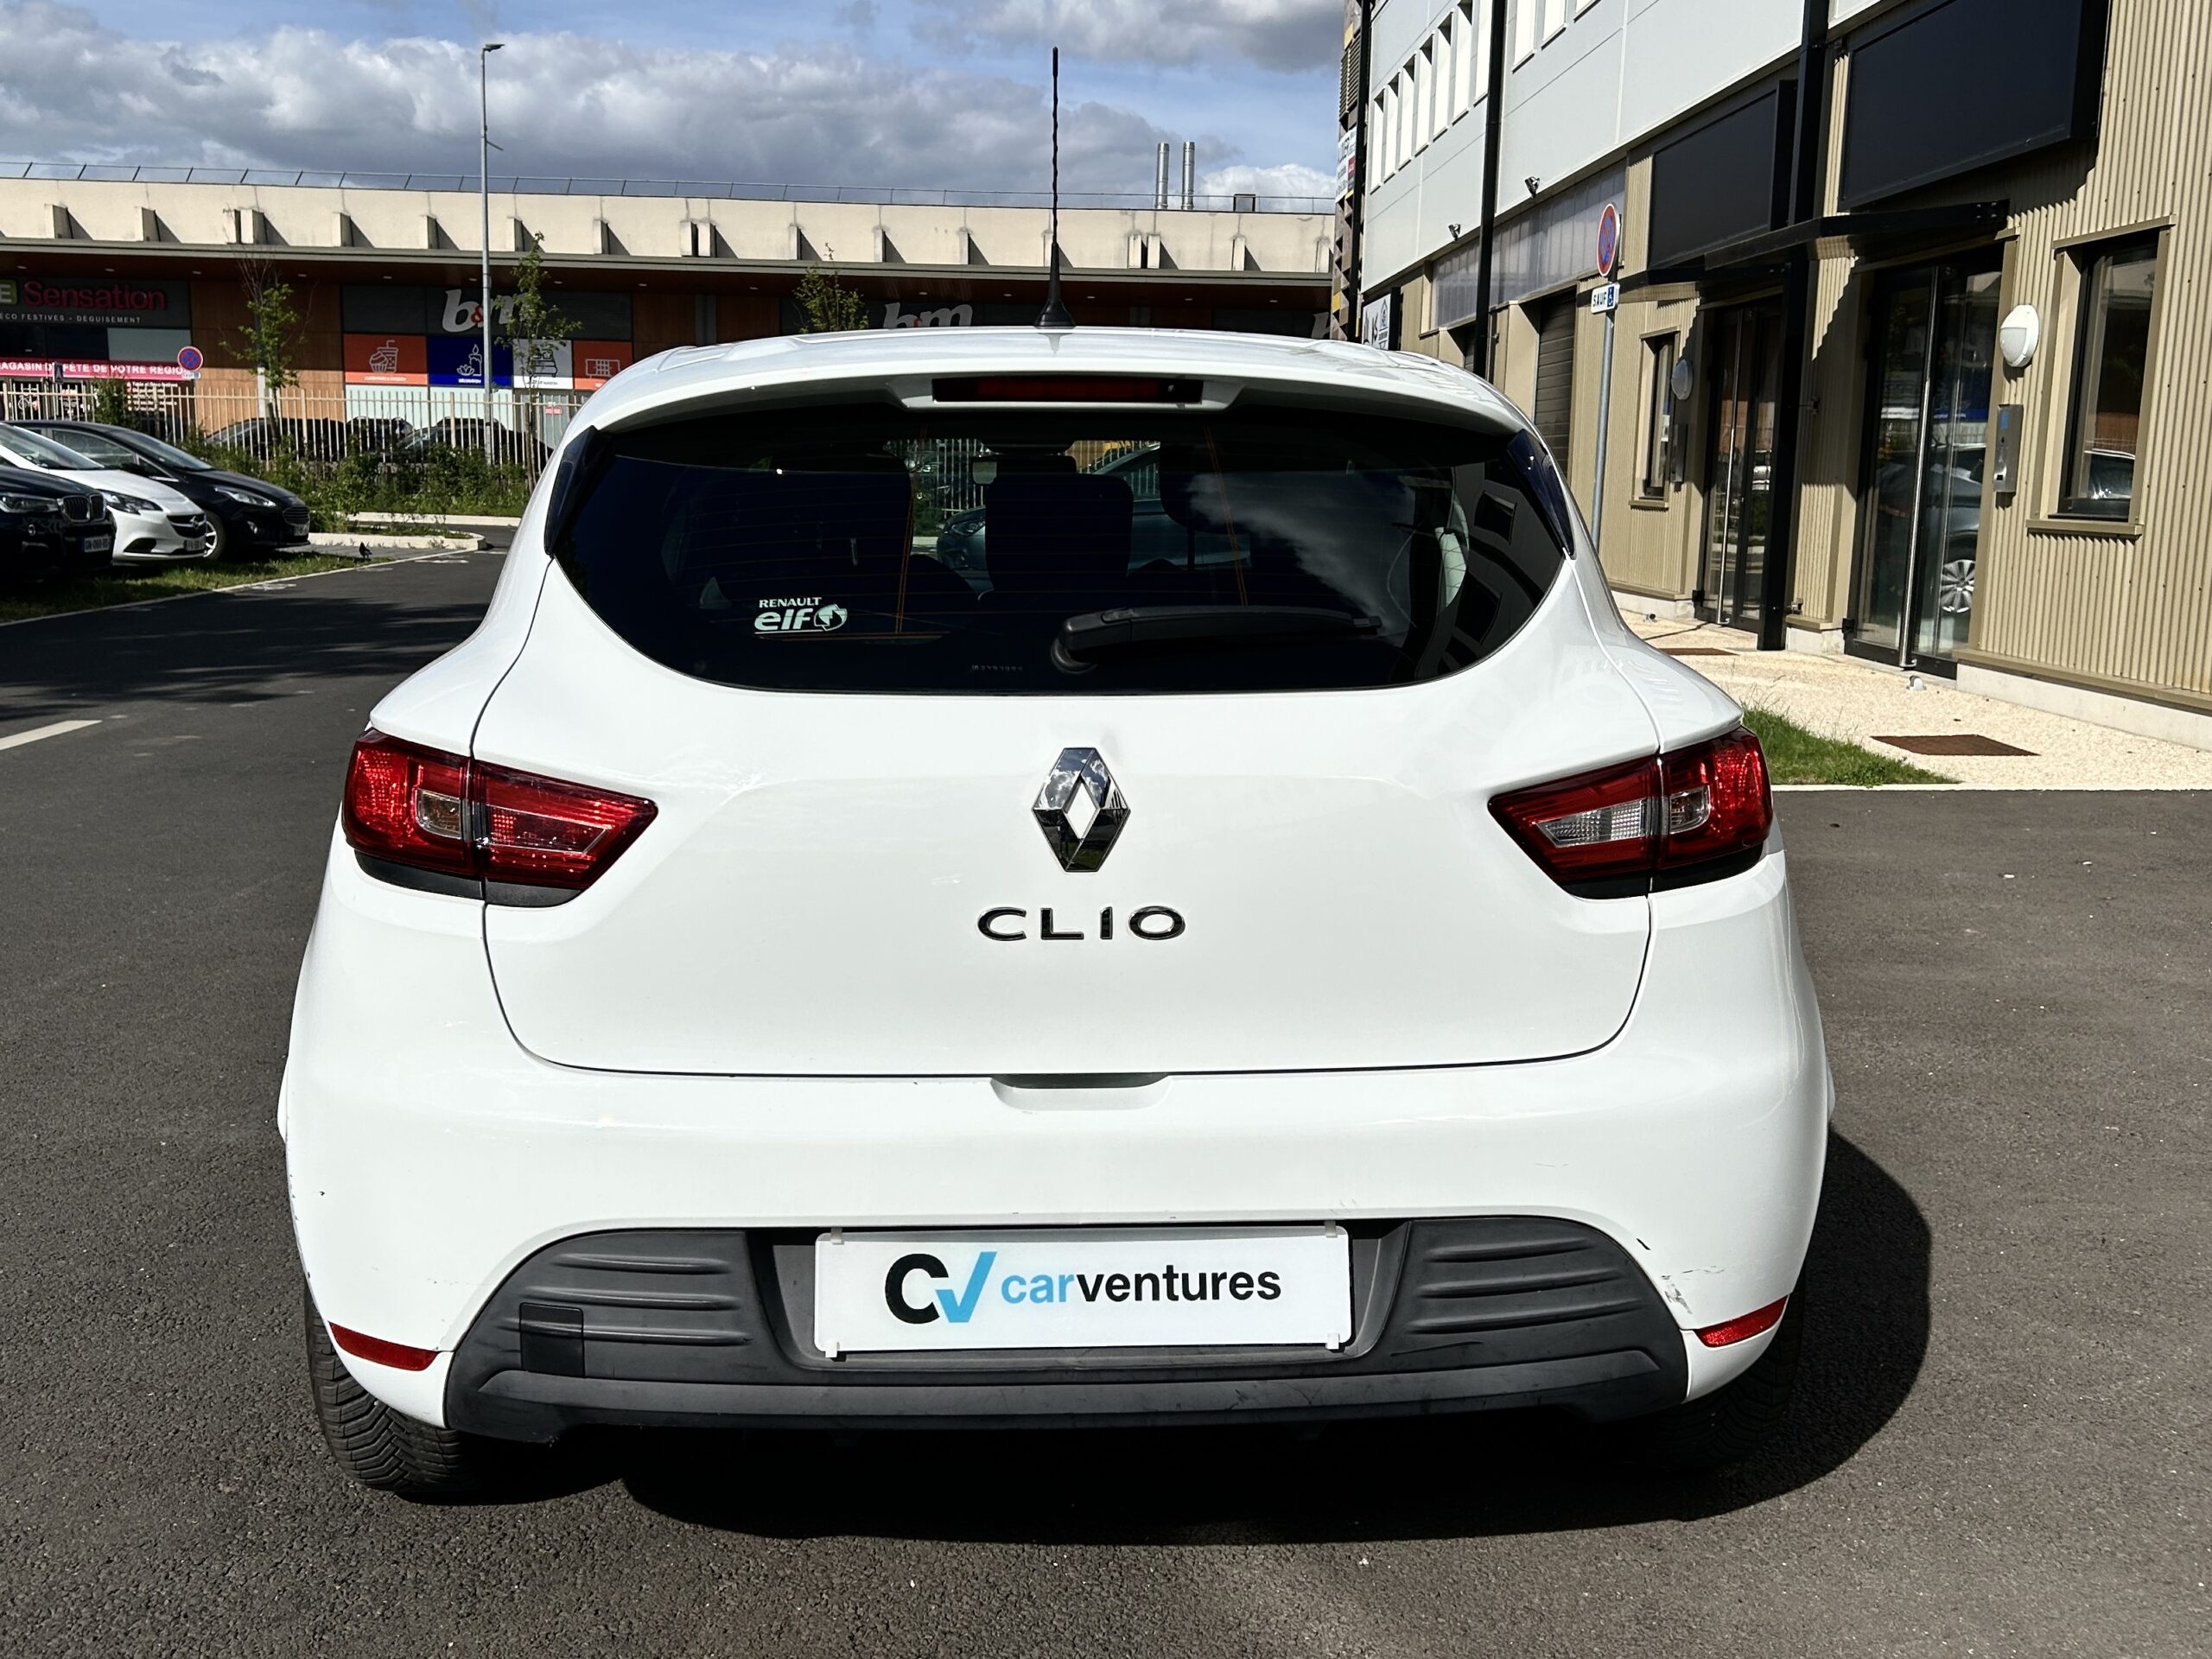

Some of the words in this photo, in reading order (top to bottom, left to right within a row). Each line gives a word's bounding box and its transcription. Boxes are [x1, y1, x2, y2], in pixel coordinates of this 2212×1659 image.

[23, 281, 166, 311] Sensation
[1592, 291, 1607, 308] SAUF
[0, 362, 42, 372] AGASIN
[93, 364, 107, 373] DE
[111, 365, 146, 374] VOTRE
[150, 365, 188, 375] RÉGIO
[759, 597, 823, 608] RENAULT
[754, 608, 814, 631] elf
[976, 906, 1186, 942] CLIO
[1001, 1264, 1282, 1305] carventures
